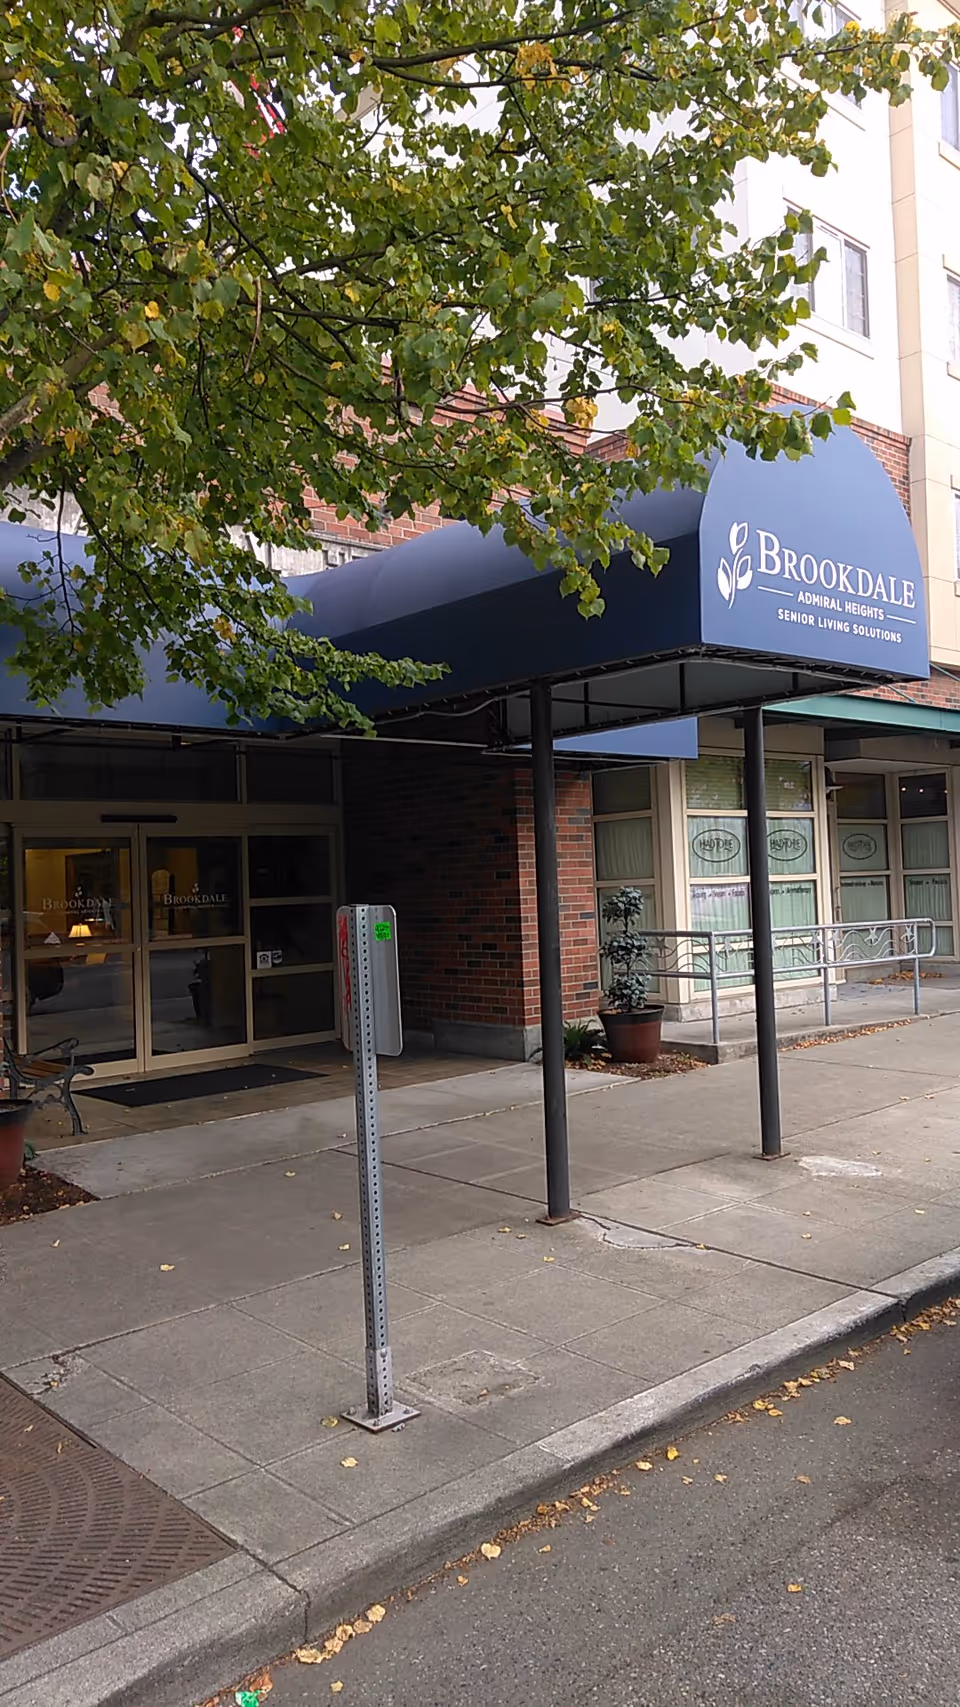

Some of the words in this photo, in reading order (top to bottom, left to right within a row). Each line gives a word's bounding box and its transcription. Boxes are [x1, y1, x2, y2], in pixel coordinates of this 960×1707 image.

[756, 529, 916, 609] BROOKDALE
[797, 591, 842, 612] ADMIRAL
[845, 601, 884, 621] HEIGHTS
[777, 608, 815, 626] SENIOR
[818, 616, 850, 633] LIVING
[852, 623, 902, 644] SOLUTIONS
[163, 893, 227, 906] BROOKDALE
